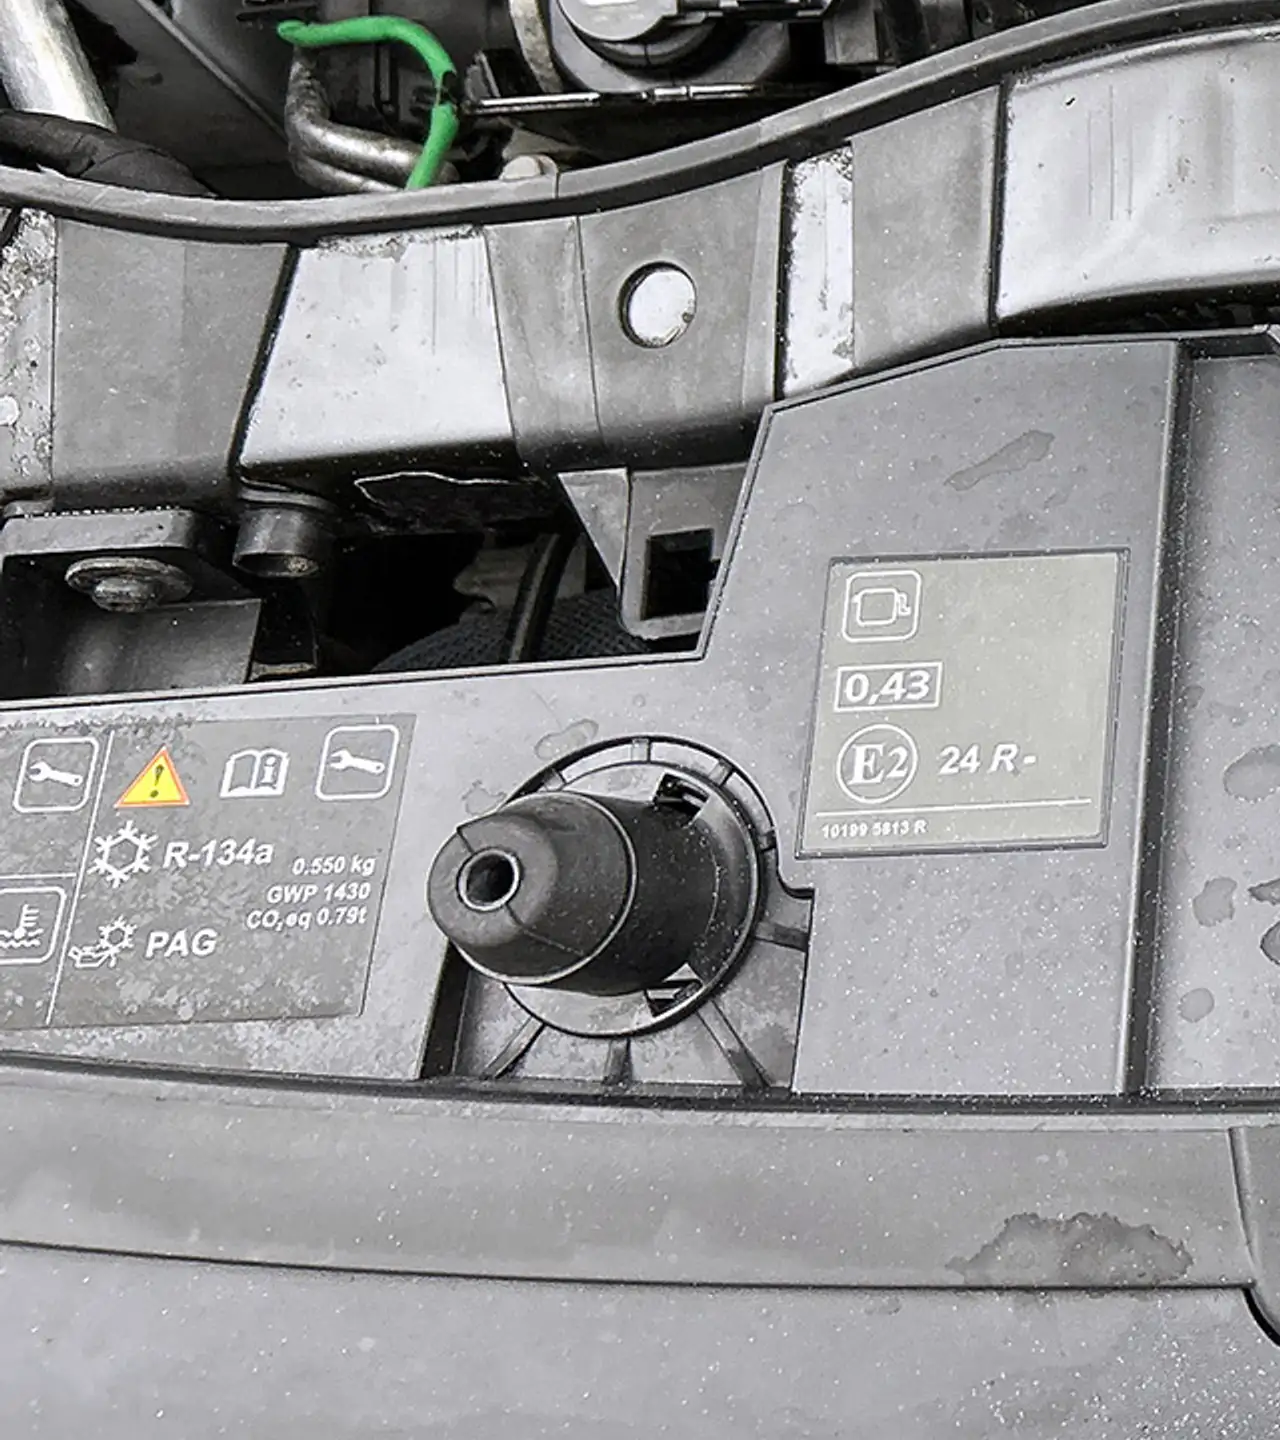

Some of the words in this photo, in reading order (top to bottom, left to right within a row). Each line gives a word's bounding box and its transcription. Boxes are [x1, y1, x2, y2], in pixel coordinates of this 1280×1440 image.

[844, 669, 931, 705] 0,43
[848, 742, 909, 786] E2
[937, 744, 981, 775] 24
[913, 819, 928, 835] R
[161, 837, 275, 869] R-134a
[350, 855, 377, 877] kg
[266, 885, 318, 904] GWP
[322, 881, 371, 902] 1430
[144, 928, 219, 959] PAG
